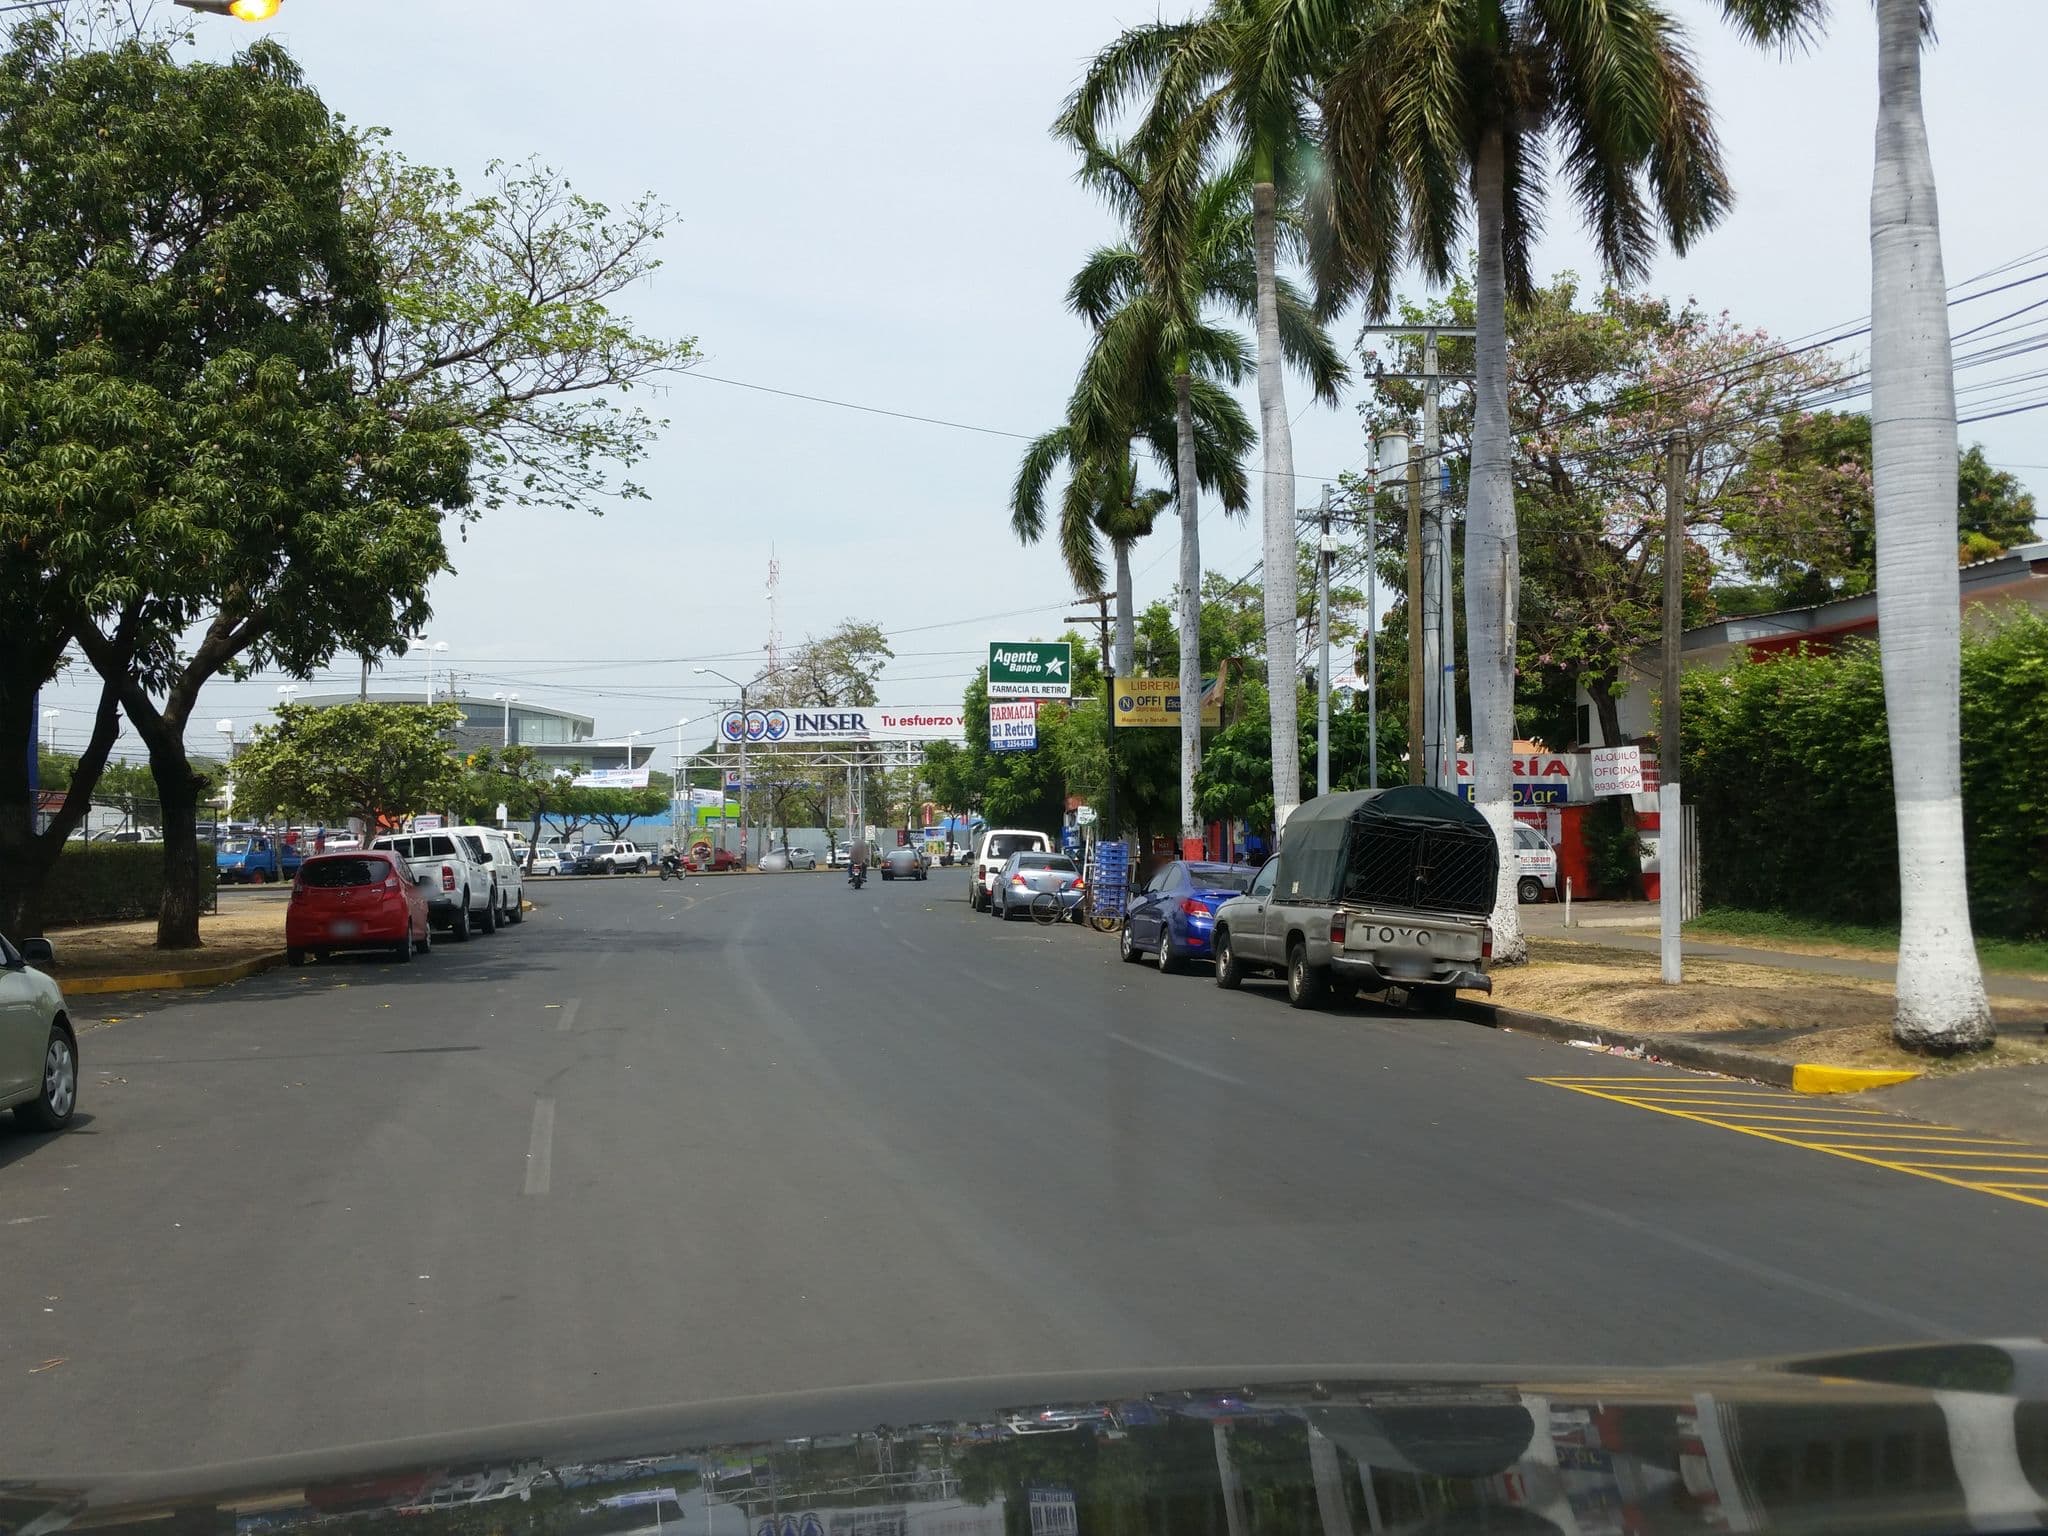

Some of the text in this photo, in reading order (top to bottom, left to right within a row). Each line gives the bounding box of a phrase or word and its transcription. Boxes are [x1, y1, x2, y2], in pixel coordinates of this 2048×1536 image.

[992, 648, 1039, 666] Agente
[1009, 663, 1042, 674] Banpro
[1042, 686, 1067, 694] RETIRO
[1136, 696, 1161, 706] OFFI
[991, 706, 1034, 721] FARMACIA
[794, 711, 871, 732] INISER
[881, 714, 965, 727] Tu esfuerzo v
[992, 721, 1034, 738] El Retiro
[1594, 750, 1638, 762] ALQUILO
[1594, 765, 1640, 777] OFICINA
[1594, 780, 1641, 792] 8930-3624
